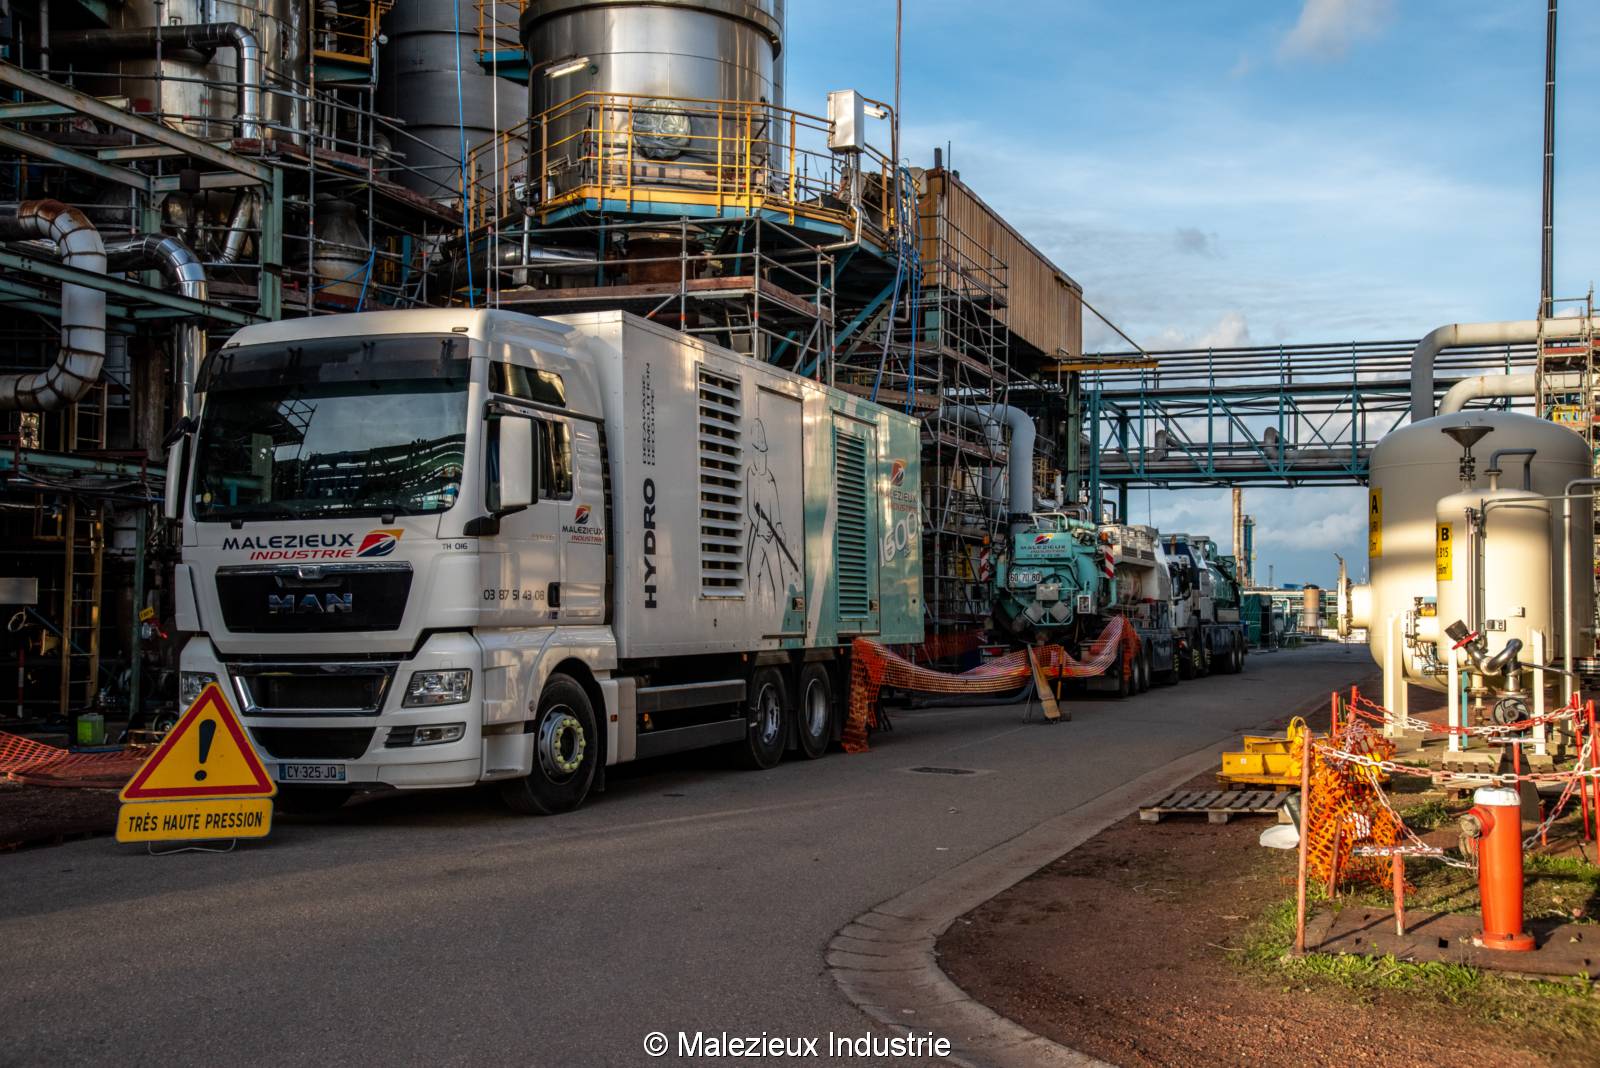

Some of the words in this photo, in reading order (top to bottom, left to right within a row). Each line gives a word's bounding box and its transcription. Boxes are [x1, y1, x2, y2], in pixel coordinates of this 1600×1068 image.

[1371, 494, 1379, 514] A
[561, 525, 604, 536] MALEZIEUX
[879, 512, 918, 568] 1600
[1441, 527, 1449, 541] B
[222, 533, 354, 551] MALEZIEUX
[642, 478, 657, 609] HYDRO
[250, 549, 354, 561] INDUSTRIE
[268, 593, 353, 615] MAN
[483, 589, 495, 601] 03
[498, 589, 510, 601] 87
[512, 589, 520, 601] 51
[522, 589, 532, 601] 43
[163, 814, 200, 831] HAUTE
[205, 811, 263, 829] PRESSION
